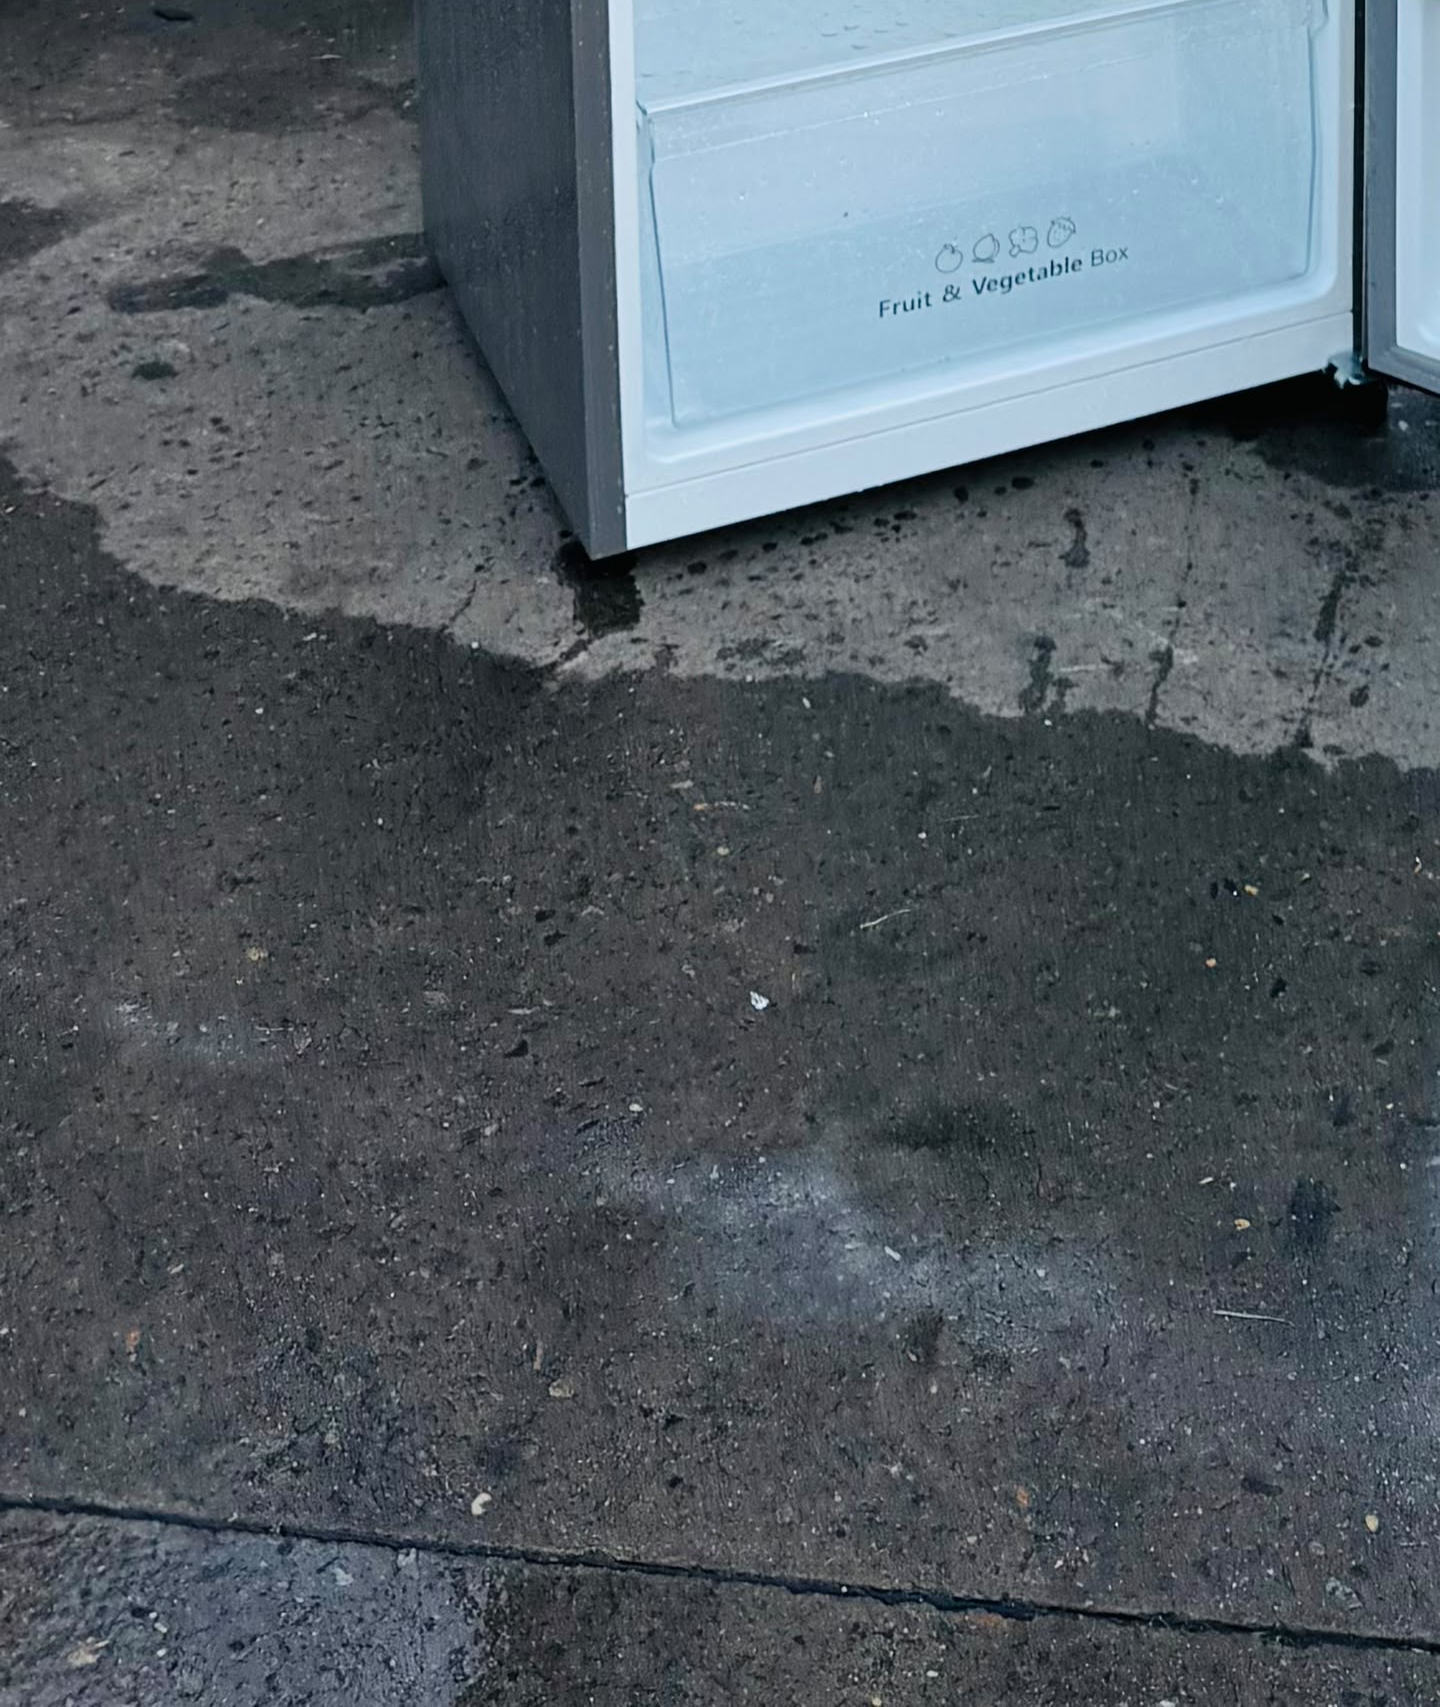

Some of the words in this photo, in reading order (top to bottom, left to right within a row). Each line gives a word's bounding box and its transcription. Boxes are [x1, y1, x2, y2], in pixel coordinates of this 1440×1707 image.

[878, 292, 932, 318] Fruit
[942, 284, 961, 304] &
[972, 256, 1083, 295] Vegetable
[1091, 247, 1129, 268] Box
